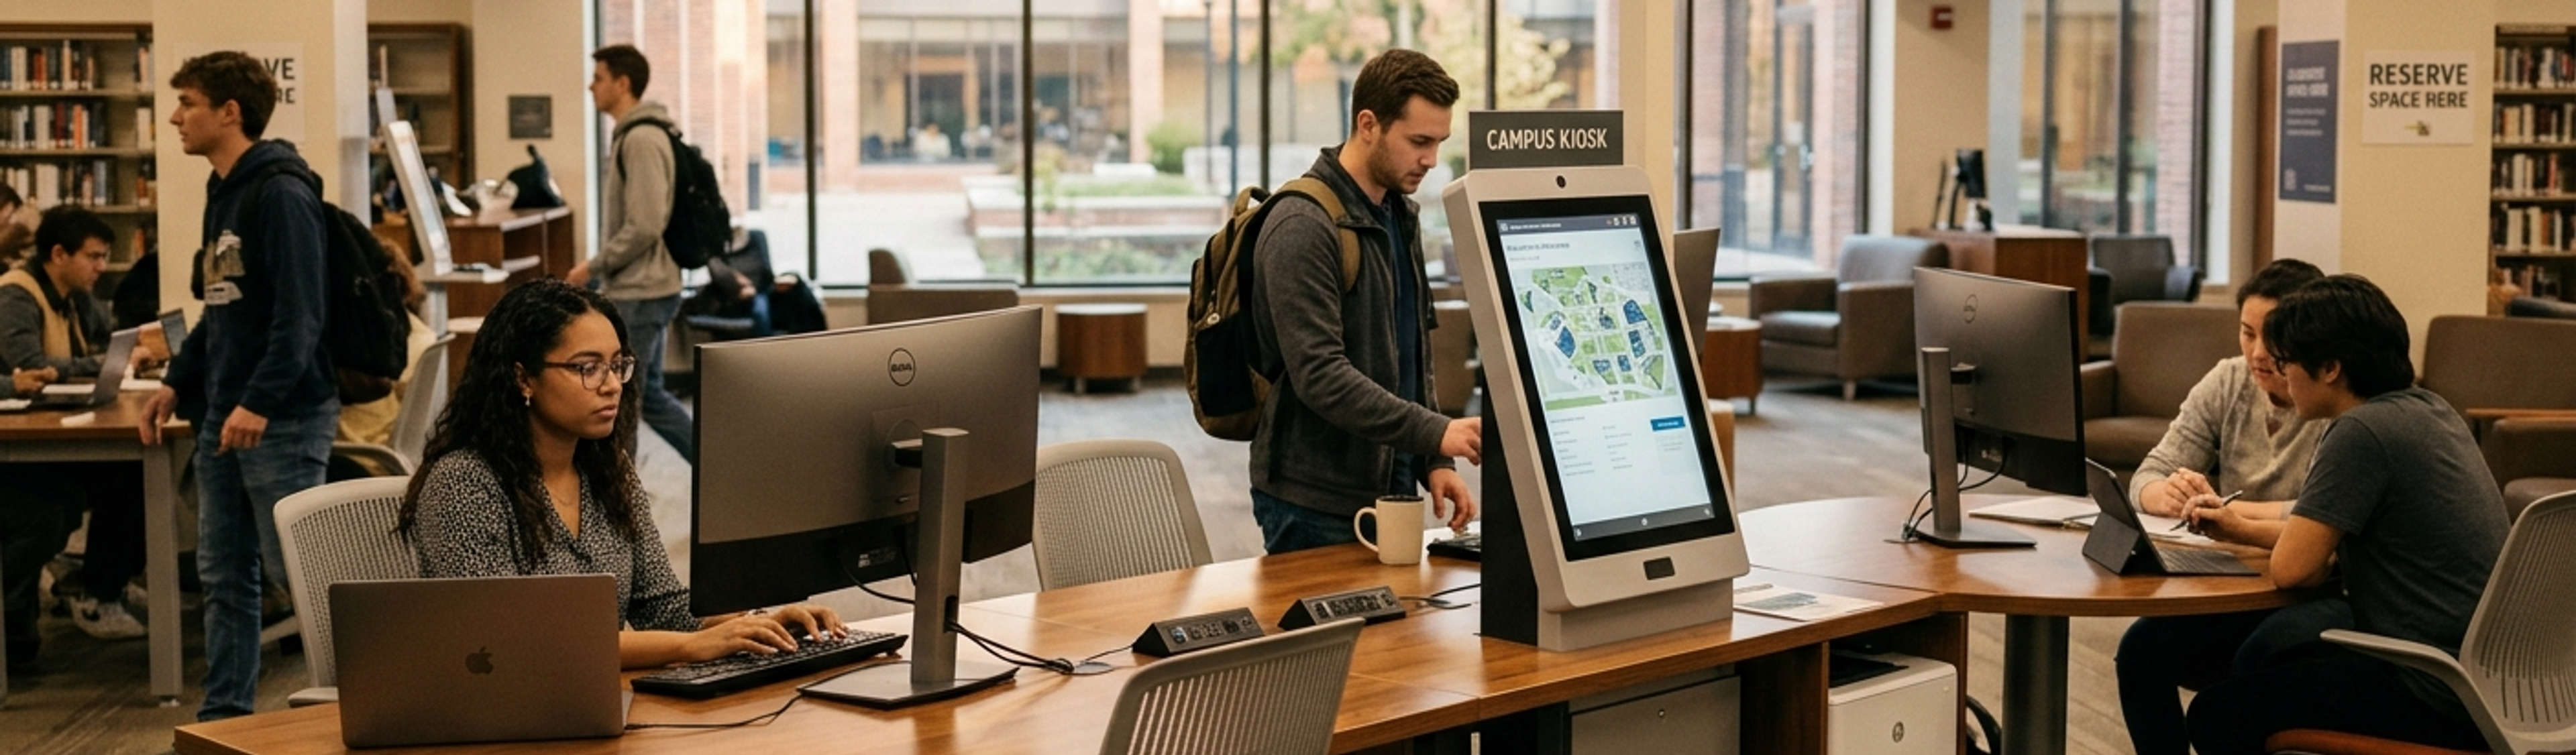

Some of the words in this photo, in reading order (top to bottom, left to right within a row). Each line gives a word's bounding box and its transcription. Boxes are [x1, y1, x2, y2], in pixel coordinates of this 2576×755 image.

[2369, 64, 2468, 85] RESERVE
[2369, 91, 2421, 109] SPACE
[1487, 129, 1555, 150] CAMPUS
[1560, 127, 1607, 149] KIOSK
